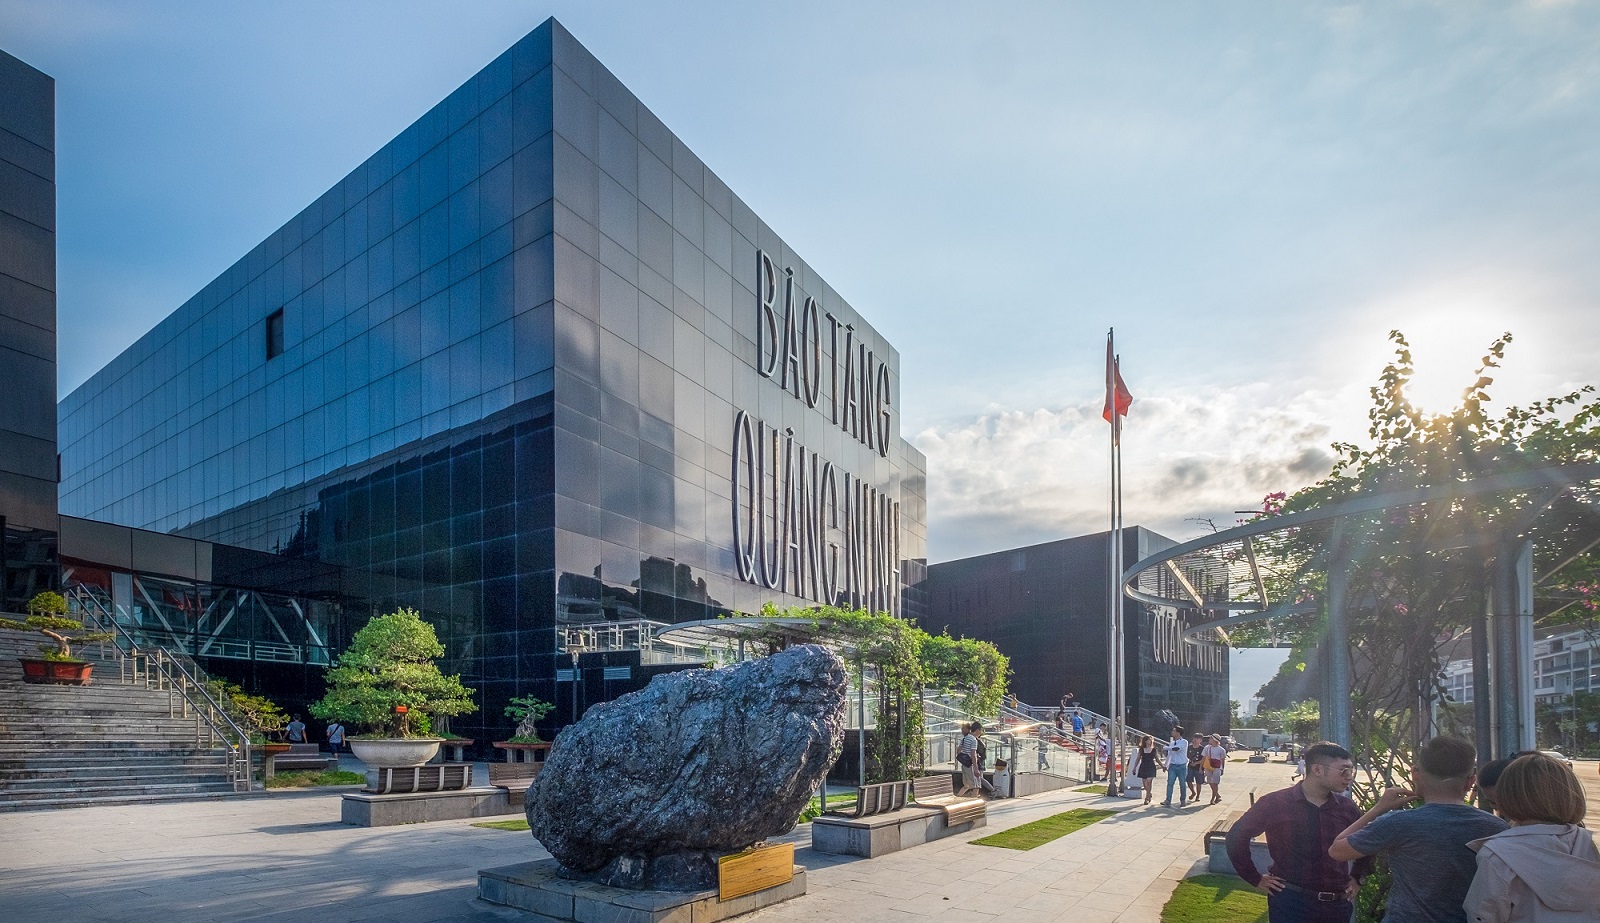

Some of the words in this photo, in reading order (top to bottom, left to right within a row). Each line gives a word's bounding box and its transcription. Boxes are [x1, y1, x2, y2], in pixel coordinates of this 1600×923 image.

[757, 249, 821, 408] BẢO
[826, 312, 891, 458] TÀNG
[732, 410, 839, 605] QUẢNG
[845, 472, 901, 618] NINH
